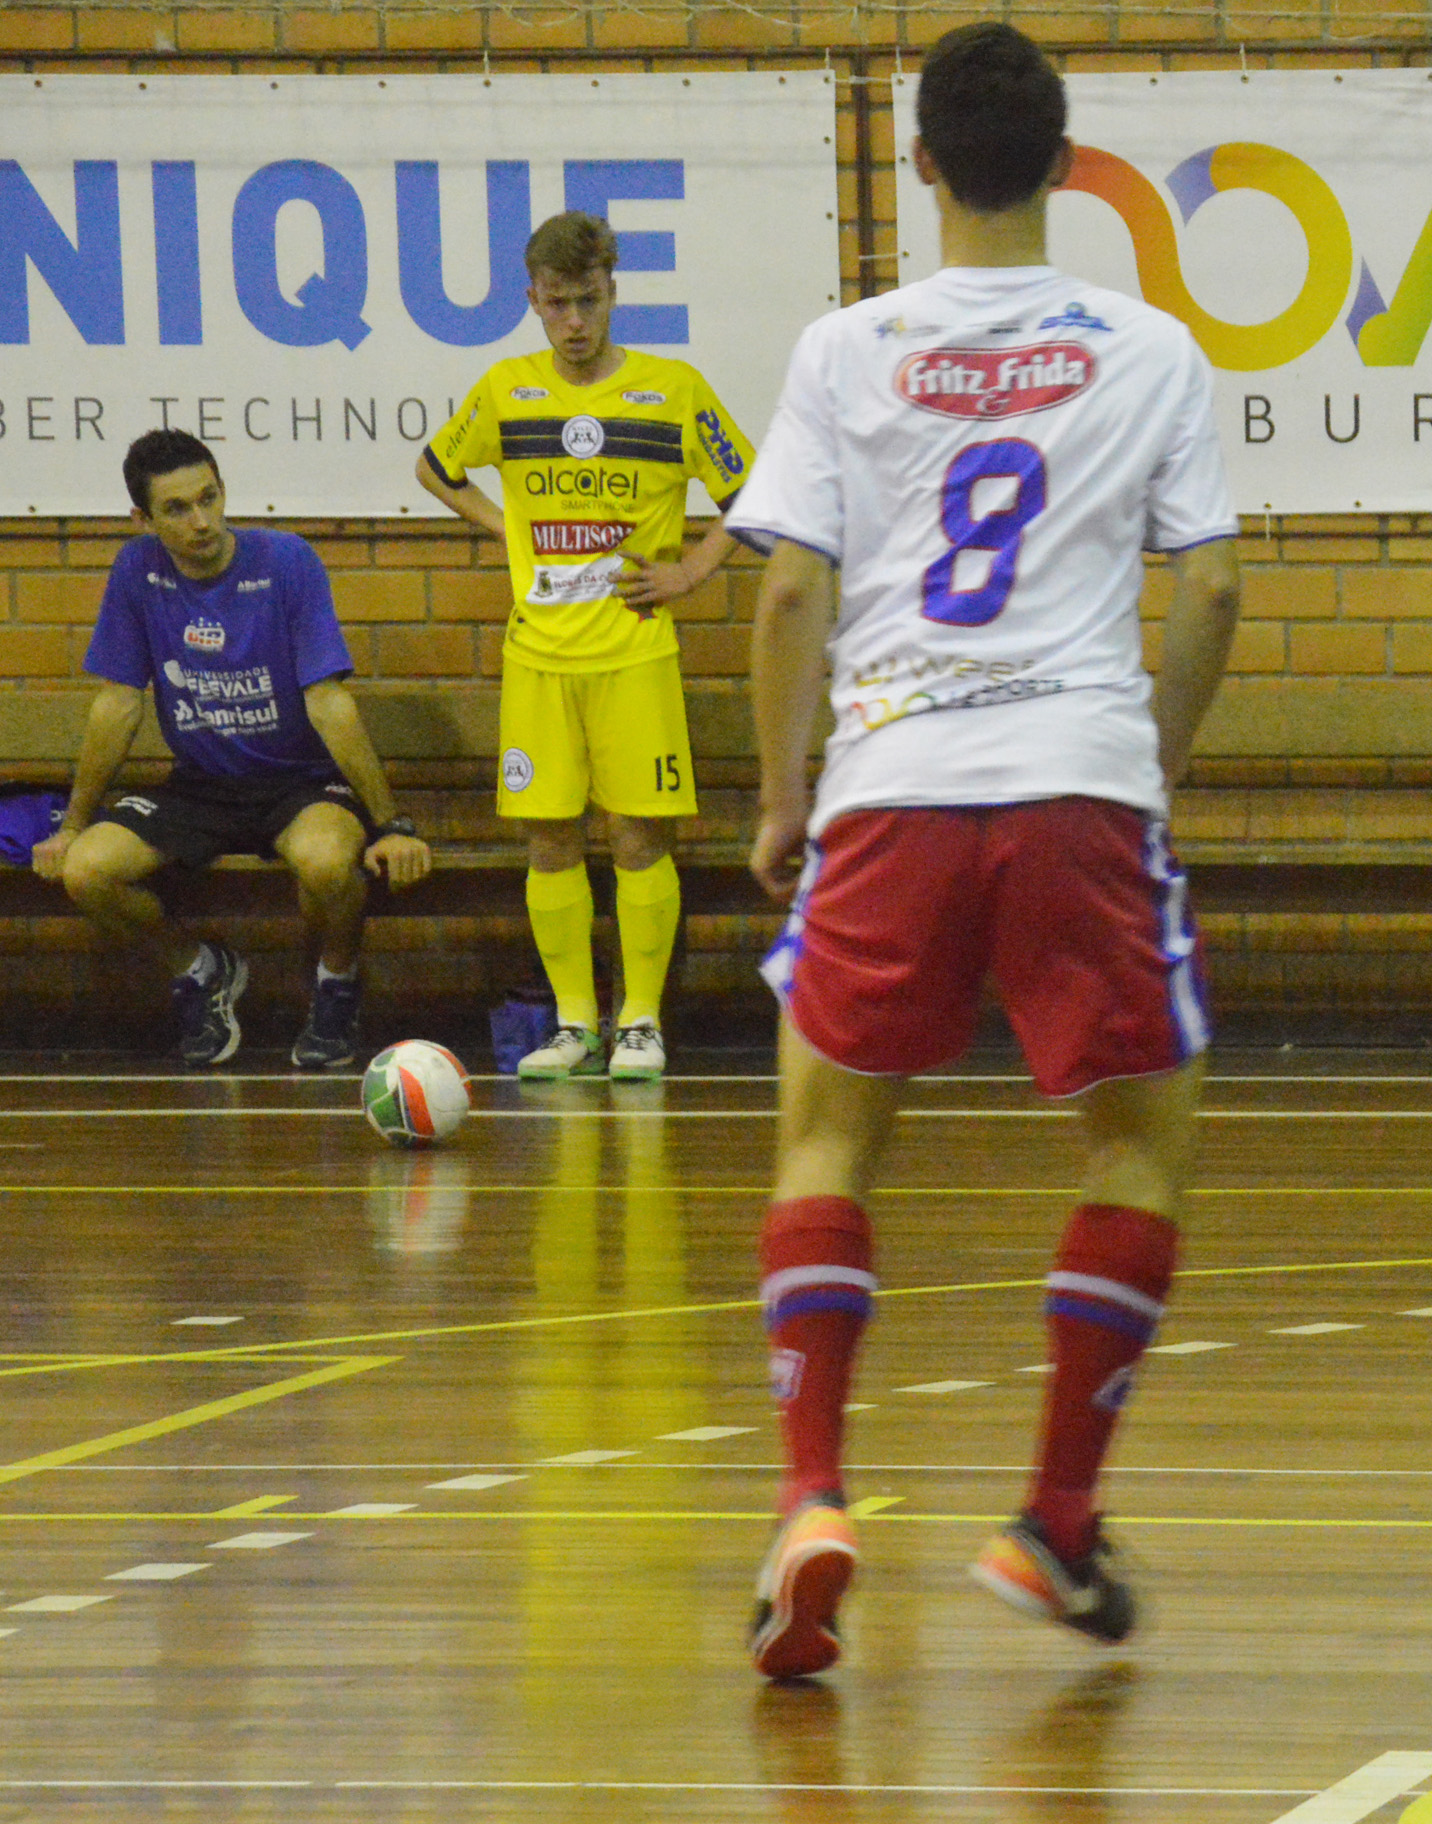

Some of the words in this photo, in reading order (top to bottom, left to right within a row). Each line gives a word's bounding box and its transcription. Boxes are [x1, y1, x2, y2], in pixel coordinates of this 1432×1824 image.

[0, 158, 691, 352] NIQUE
[0, 397, 106, 442] ER
[695, 406, 745, 475] PHD
[525, 465, 639, 499] alcatel
[560, 500, 635, 514] SMARTPHONE
[920, 437, 1048, 628] 8
[186, 674, 274, 697] FEEVALE
[654, 753, 681, 792] 15
